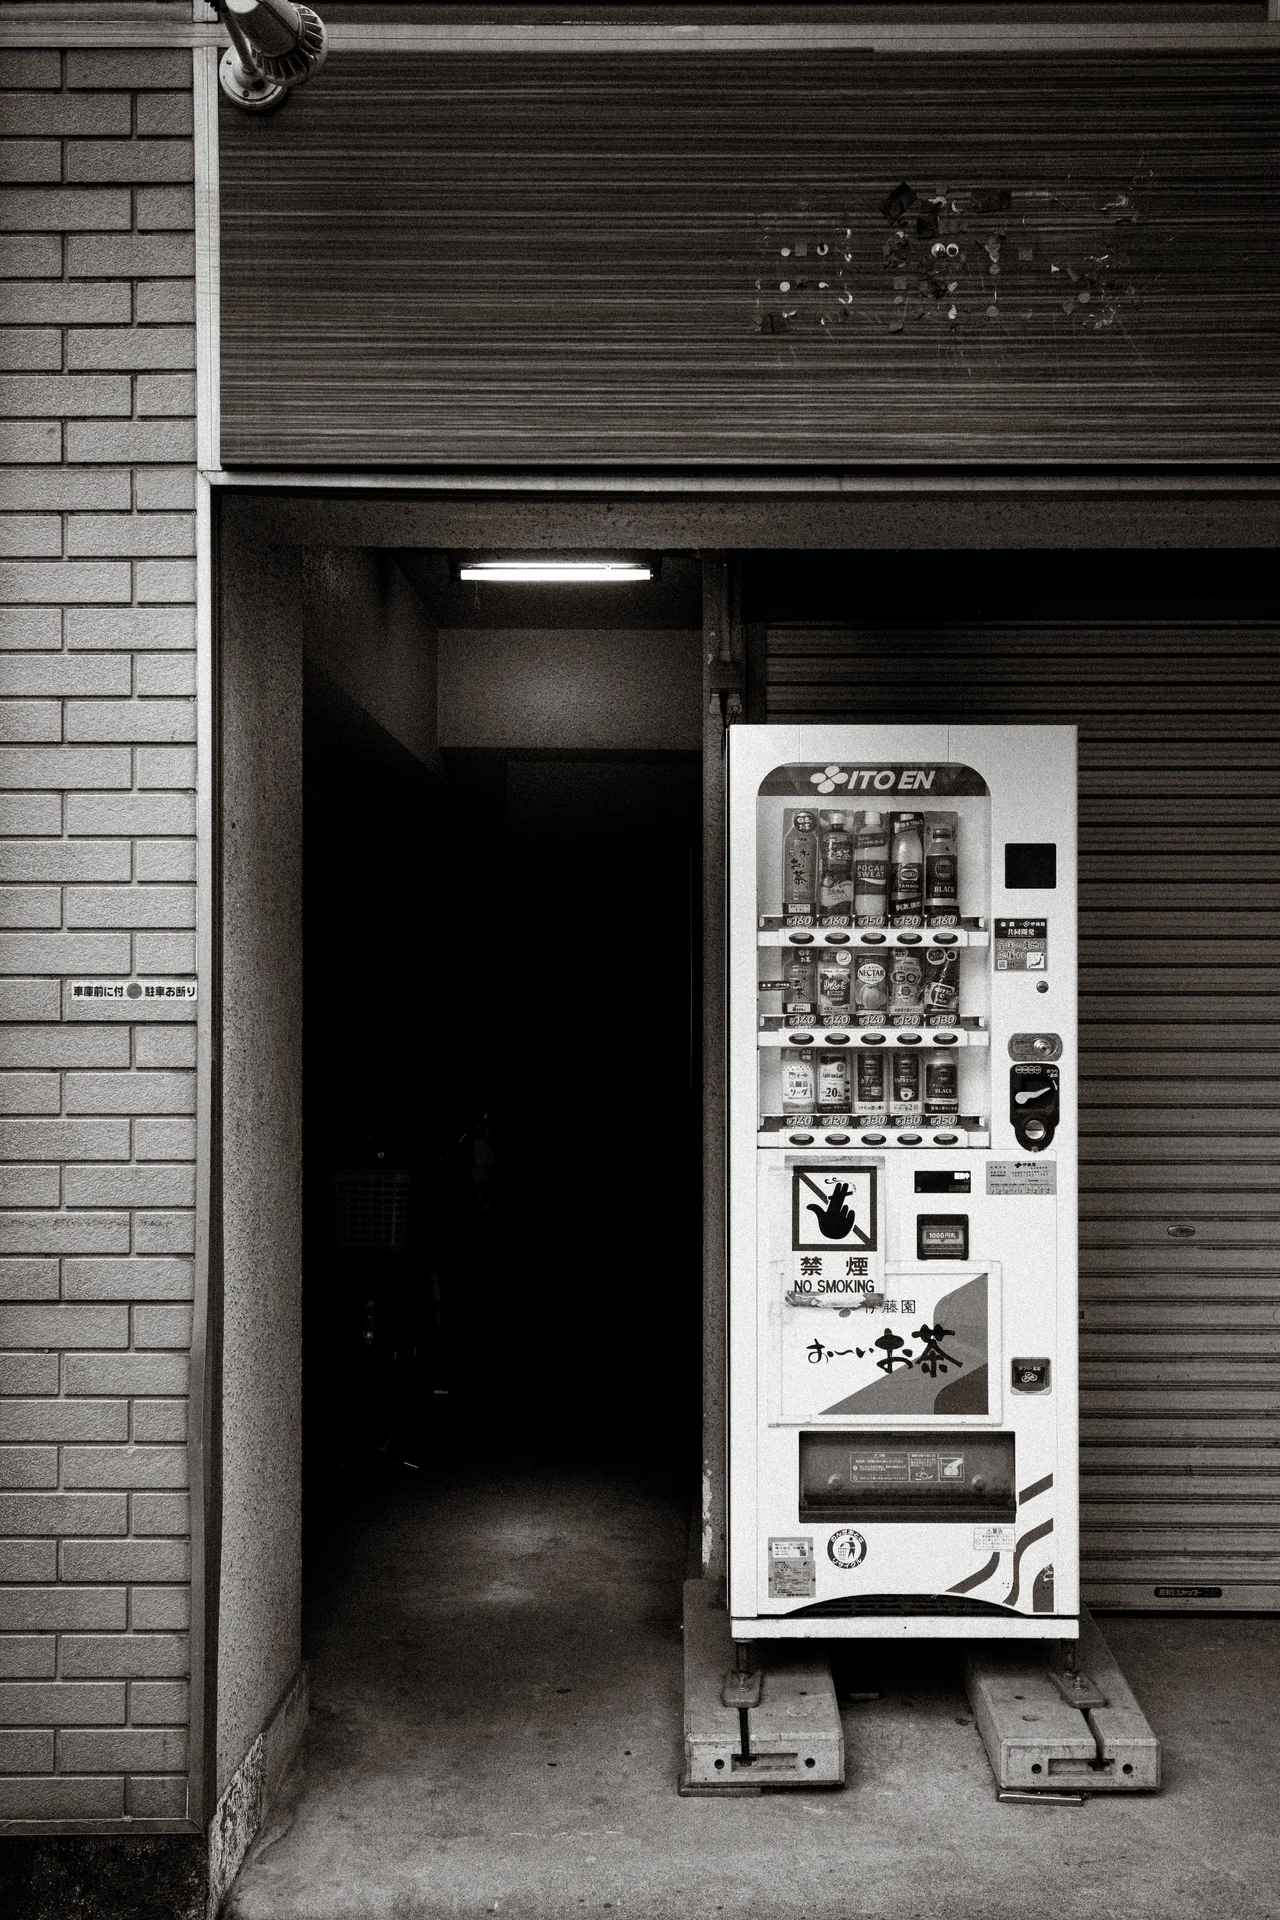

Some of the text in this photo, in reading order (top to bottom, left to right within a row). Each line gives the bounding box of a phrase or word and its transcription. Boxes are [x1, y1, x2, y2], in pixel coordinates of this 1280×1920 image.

[848, 770, 936, 790] ITO EN
[934, 885, 955, 893] BLACK
[858, 969, 885, 977] NECTAR
[73, 986, 196, 997] 車庫前に付 駐車お断り
[825, 1087, 838, 1098] 20
[794, 1279, 875, 1293] NO SMOKING
